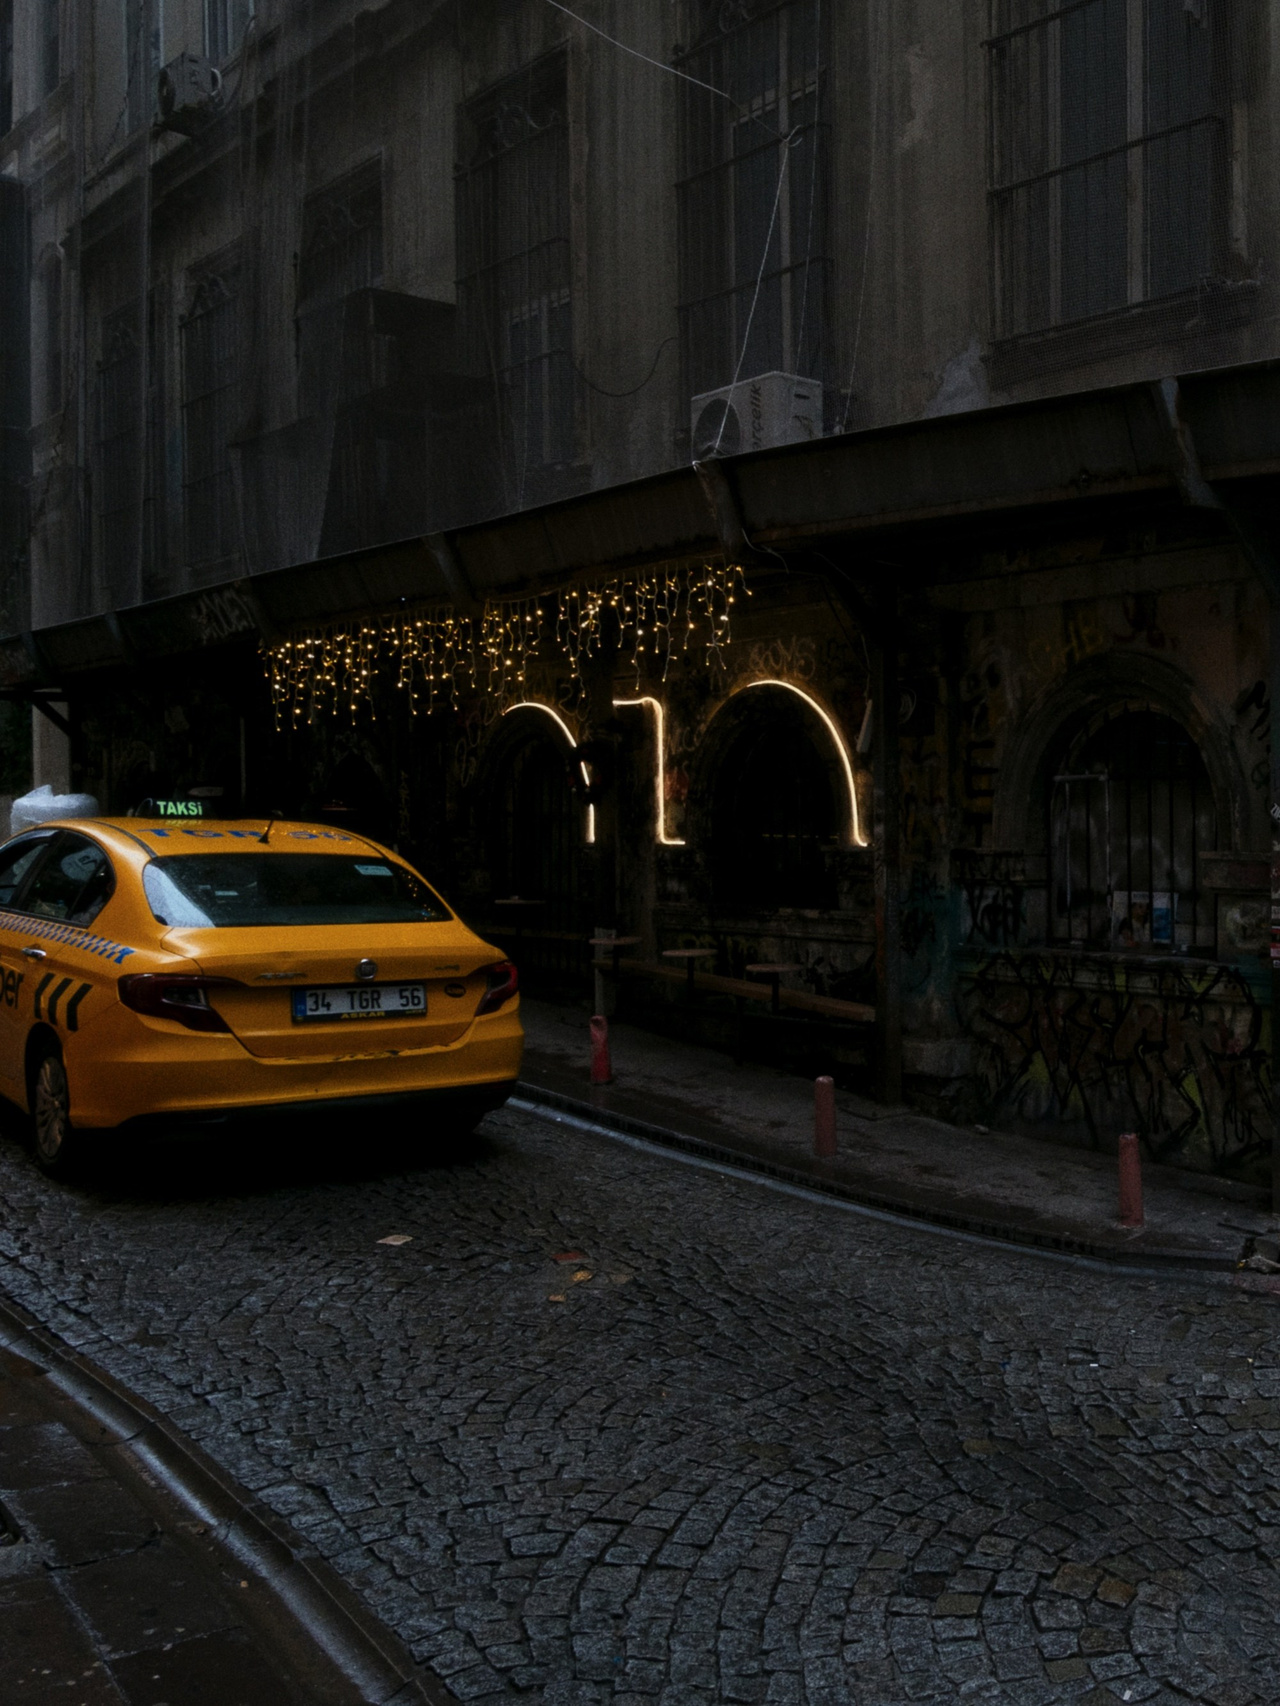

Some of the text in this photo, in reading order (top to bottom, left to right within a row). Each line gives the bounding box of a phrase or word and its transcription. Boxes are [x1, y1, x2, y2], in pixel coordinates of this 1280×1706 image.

[308, 992, 332, 1012] 34
[347, 990, 382, 1011] TGR
[399, 986, 422, 1008] 56
[340, 1010, 386, 1020] ASKAR
